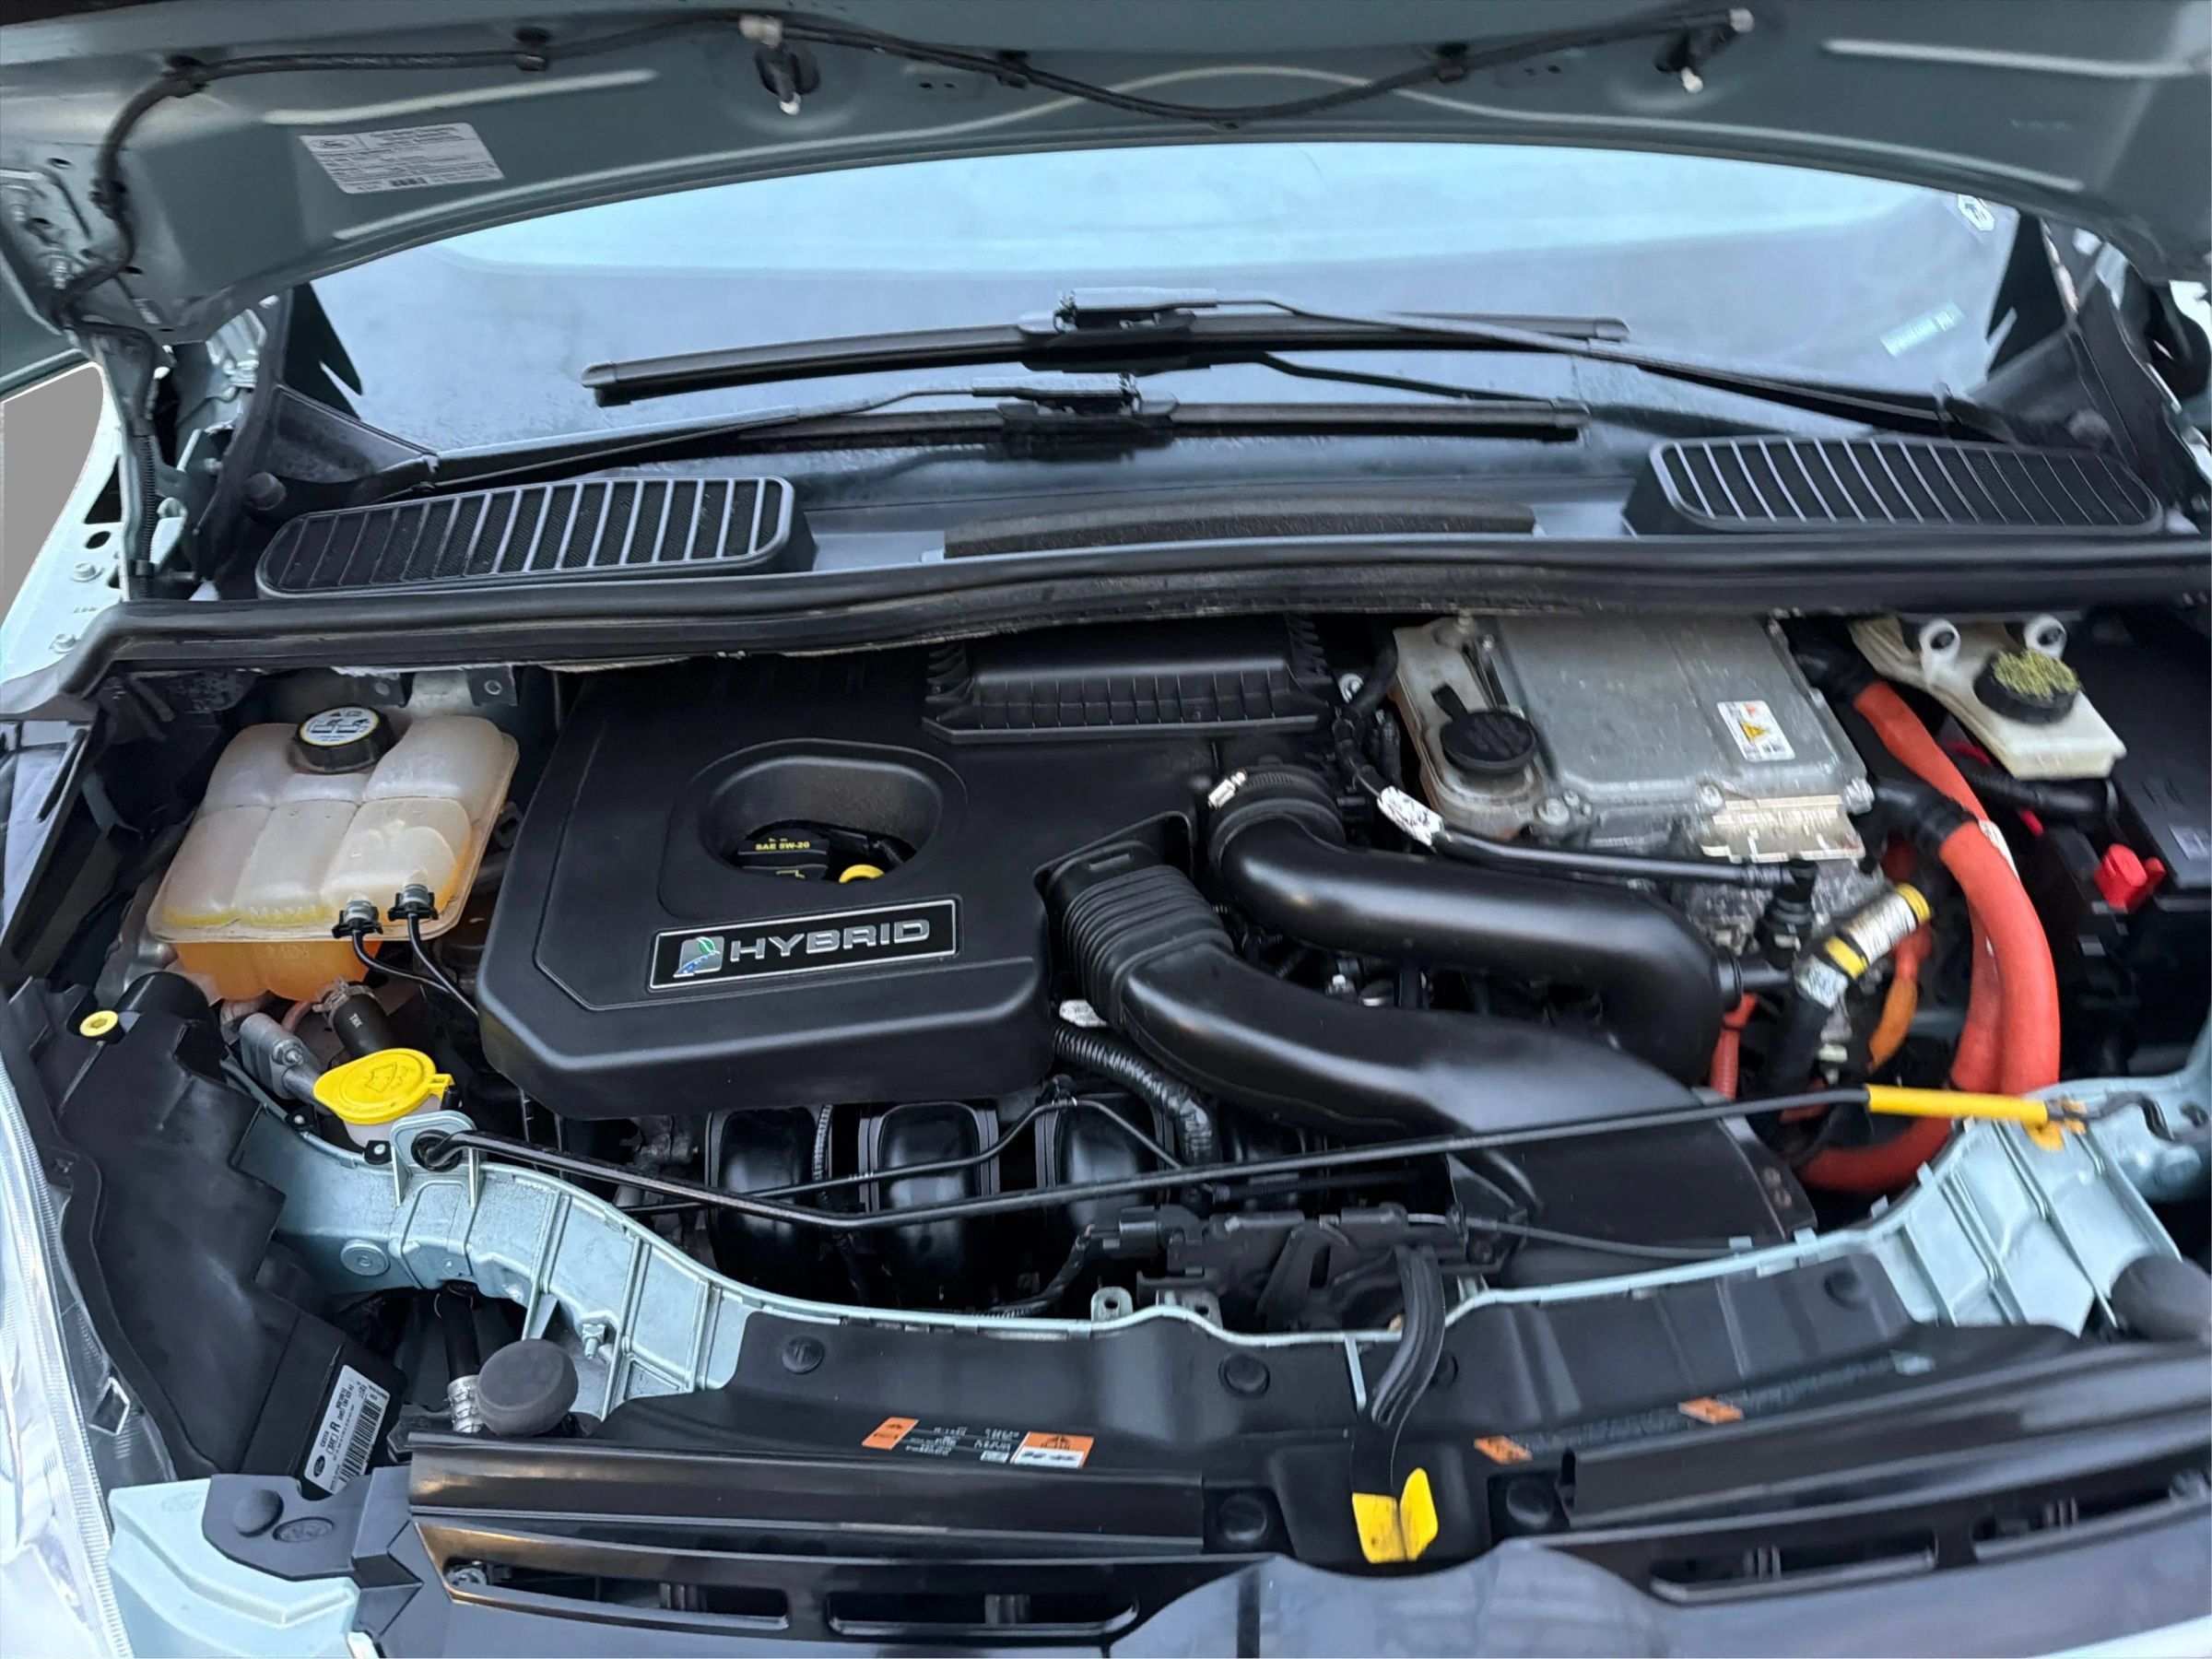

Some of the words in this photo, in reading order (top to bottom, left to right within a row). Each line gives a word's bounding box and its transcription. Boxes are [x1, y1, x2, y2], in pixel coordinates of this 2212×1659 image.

[755, 842, 777, 851] SAE
[779, 841, 811, 850] 5W-20
[730, 919, 930, 962] HYBRID
[329, 1420, 341, 1433] R
